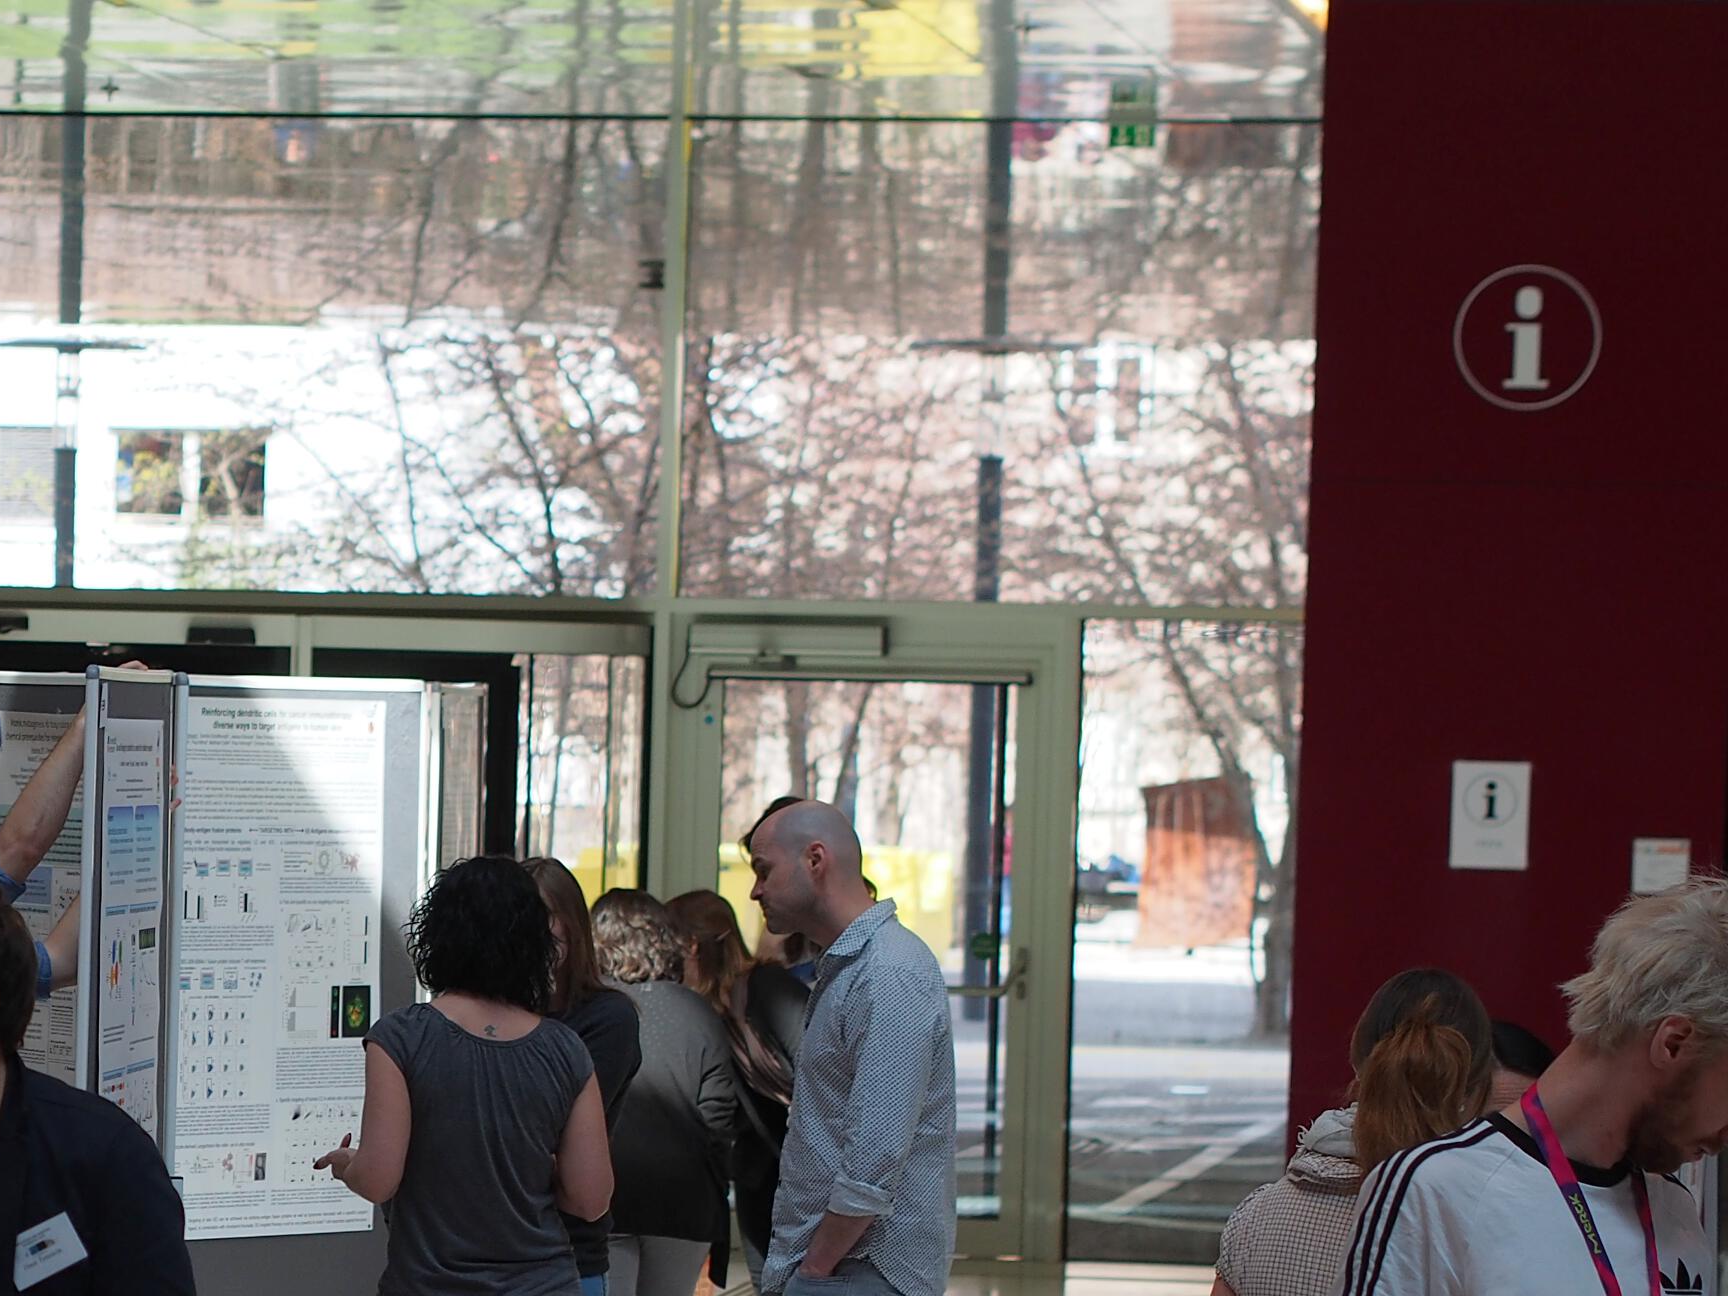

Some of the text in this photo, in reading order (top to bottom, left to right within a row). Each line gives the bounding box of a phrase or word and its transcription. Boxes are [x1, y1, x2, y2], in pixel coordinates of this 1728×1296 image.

[201, 706, 236, 719] Reinforcing
[237, 707, 263, 718] dendritic
[235, 722, 250, 732] ways
[251, 721, 258, 731] to
